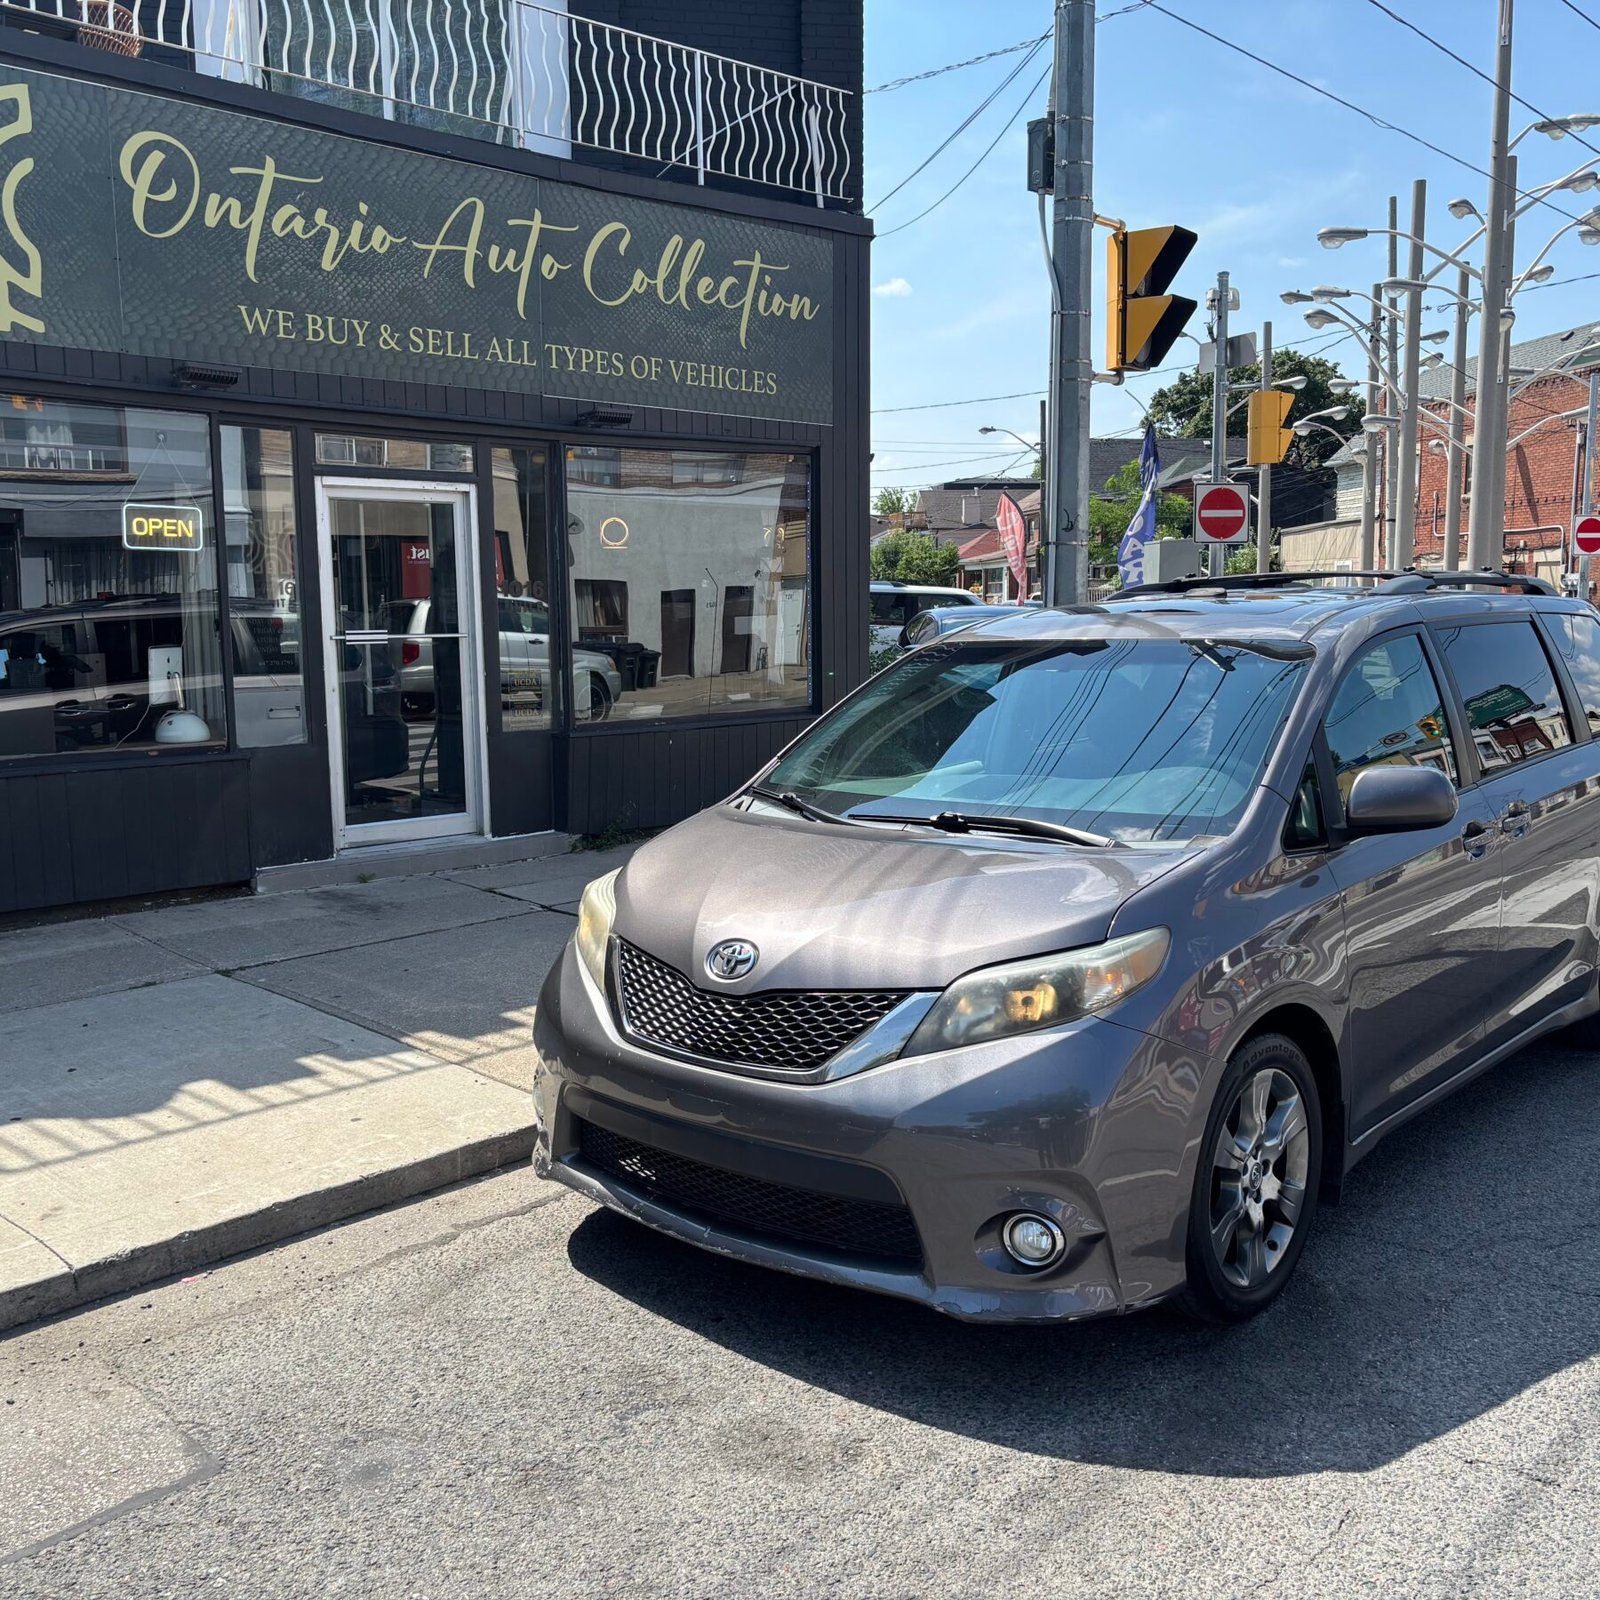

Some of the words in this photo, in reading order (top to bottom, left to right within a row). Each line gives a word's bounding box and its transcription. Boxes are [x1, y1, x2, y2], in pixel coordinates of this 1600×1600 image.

[119, 130, 406, 283] Ontario
[411, 197, 579, 320] Auto
[582, 221, 819, 350] Collection
[238, 304, 296, 339] WE
[305, 313, 372, 347] BUY
[379, 324, 402, 351] &
[408, 326, 480, 359] SELL
[485, 336, 537, 366] ALL
[544, 343, 625, 379] TYPES
[630, 354, 663, 382] OF
[668, 359, 778, 395] VEHICLES
[132, 517, 193, 538] OPEN
[1243, 1043, 1302, 1072] Advantage
